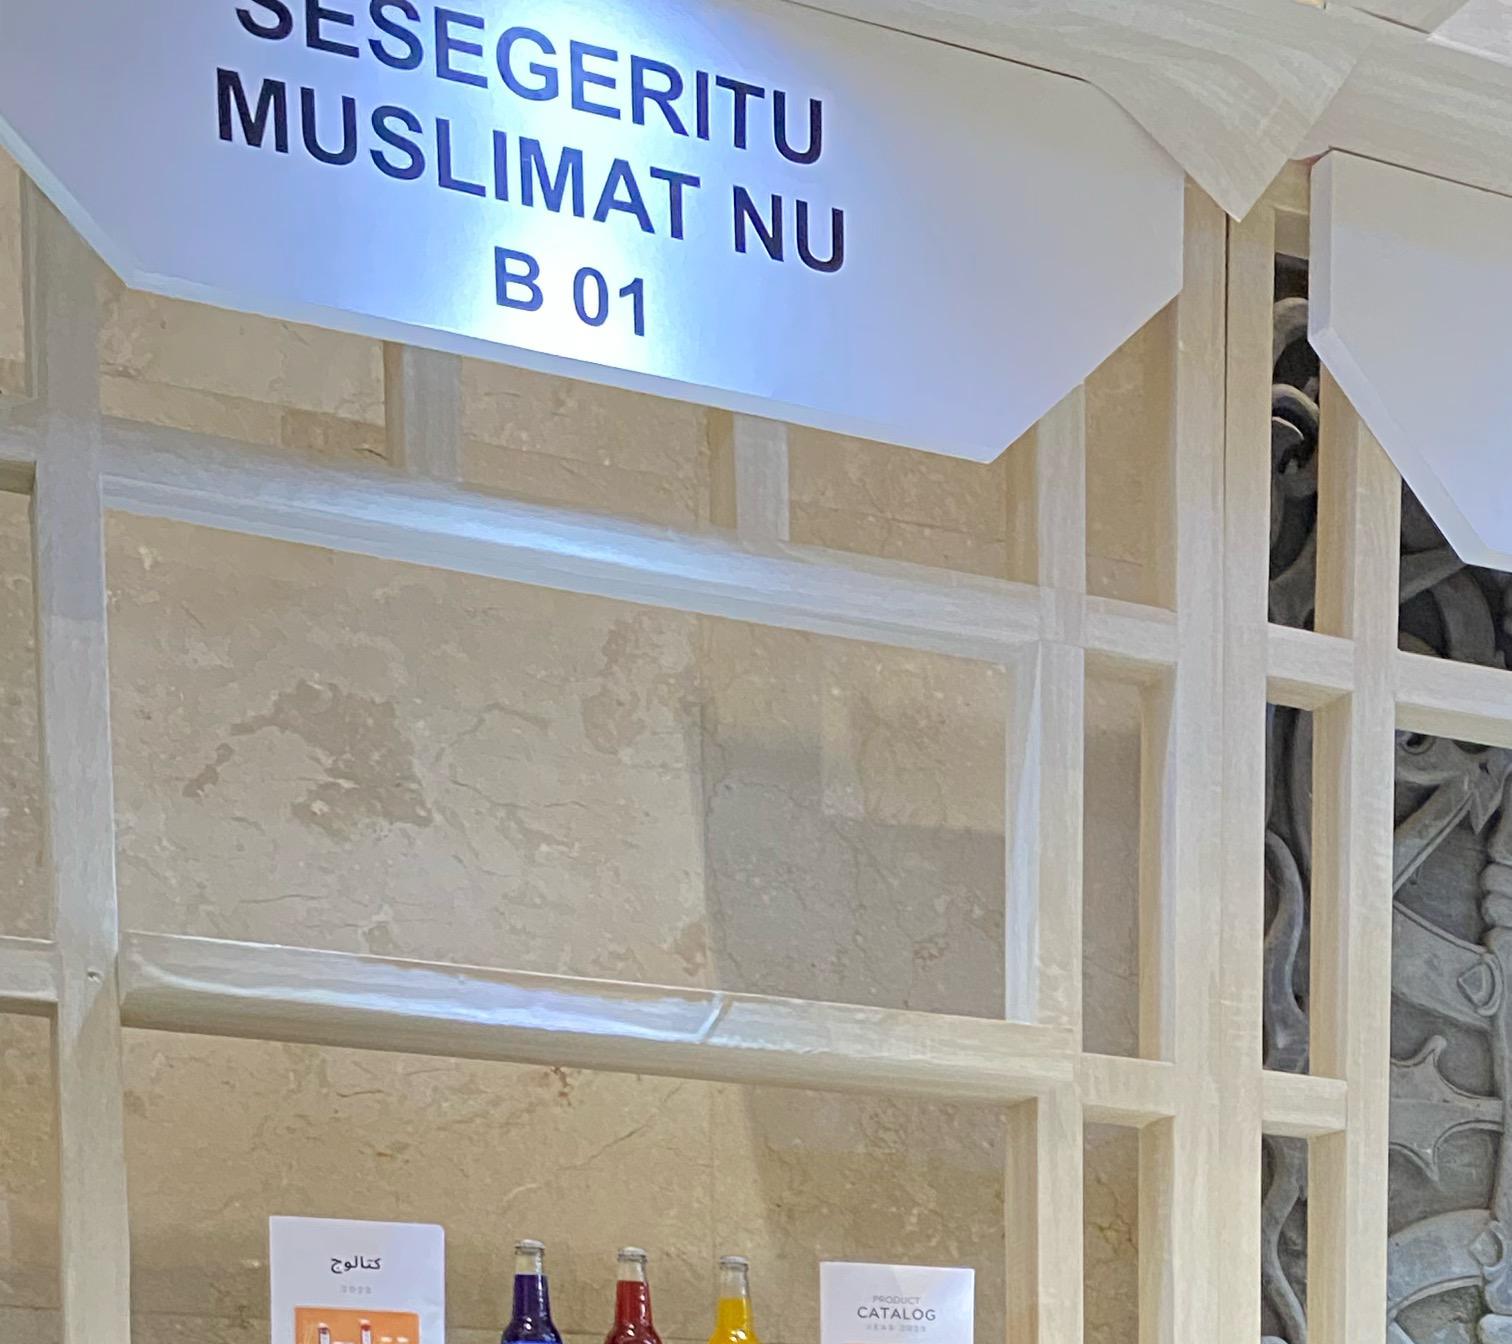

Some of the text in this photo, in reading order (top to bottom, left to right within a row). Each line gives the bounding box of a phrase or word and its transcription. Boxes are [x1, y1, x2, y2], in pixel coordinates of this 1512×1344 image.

[235, 0, 823, 165] SESEGERITU
[216, 66, 845, 273] MUSLIMAT NU
[494, 246, 646, 337] B 01
[330, 1255, 382, 1274] كتالوج
[857, 1306, 936, 1321] CATALOG
[872, 1295, 921, 1305] PRODUCT
